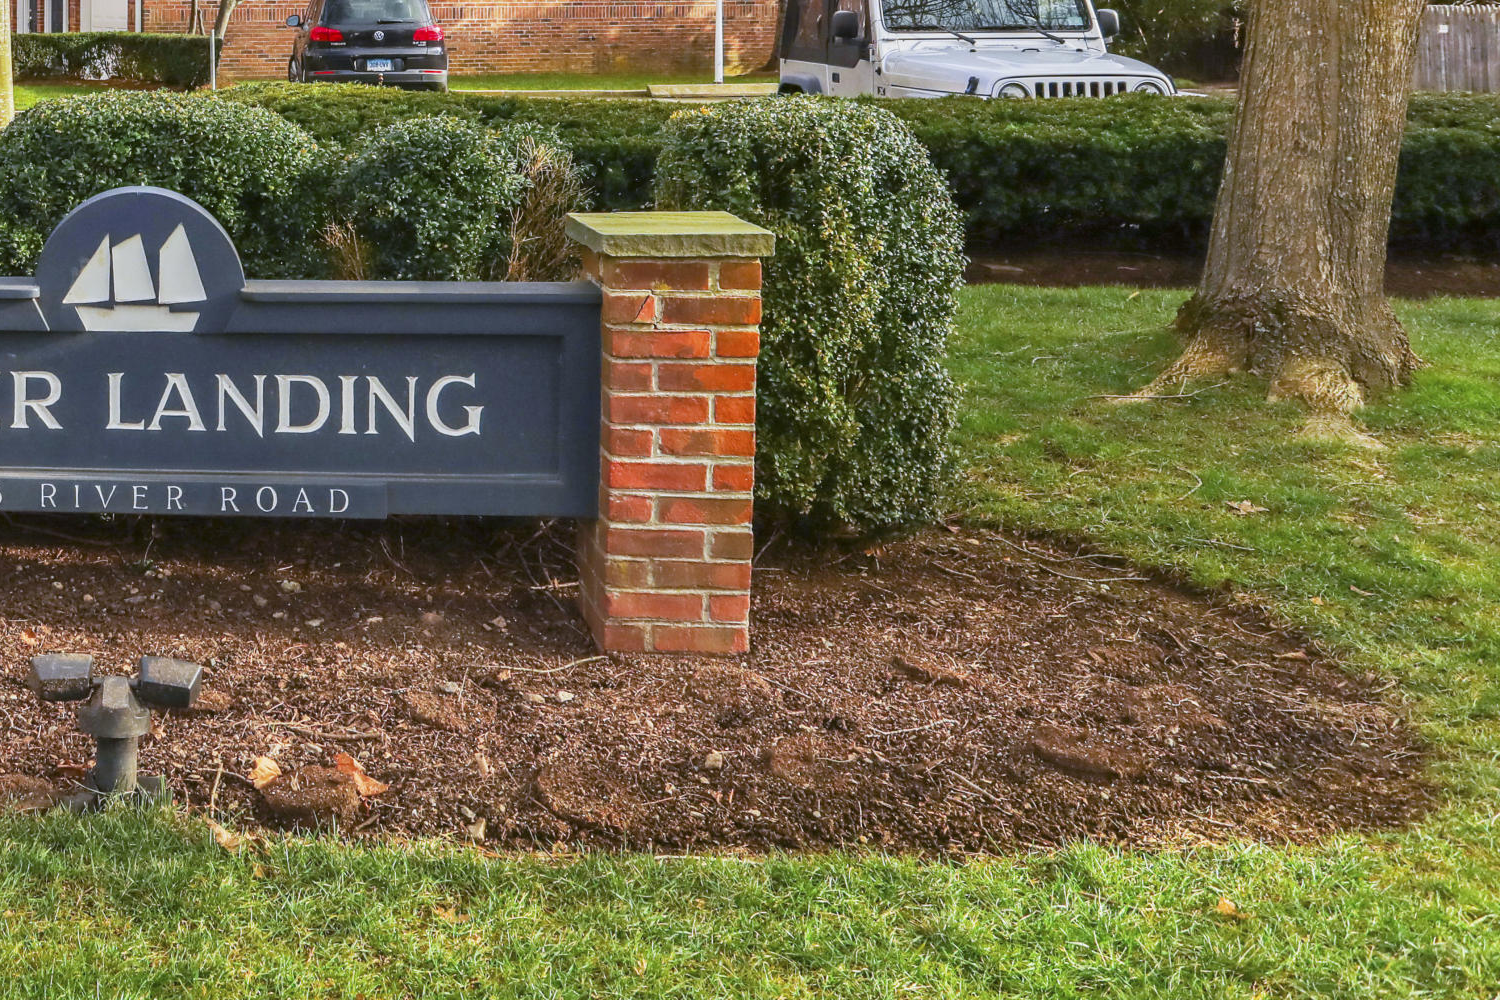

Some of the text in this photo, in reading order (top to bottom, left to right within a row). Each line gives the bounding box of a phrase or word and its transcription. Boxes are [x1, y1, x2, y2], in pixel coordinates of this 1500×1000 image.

[105, 372, 485, 443] LANDING
[40, 483, 184, 511] RIVER
[221, 486, 351, 514] ROAD
